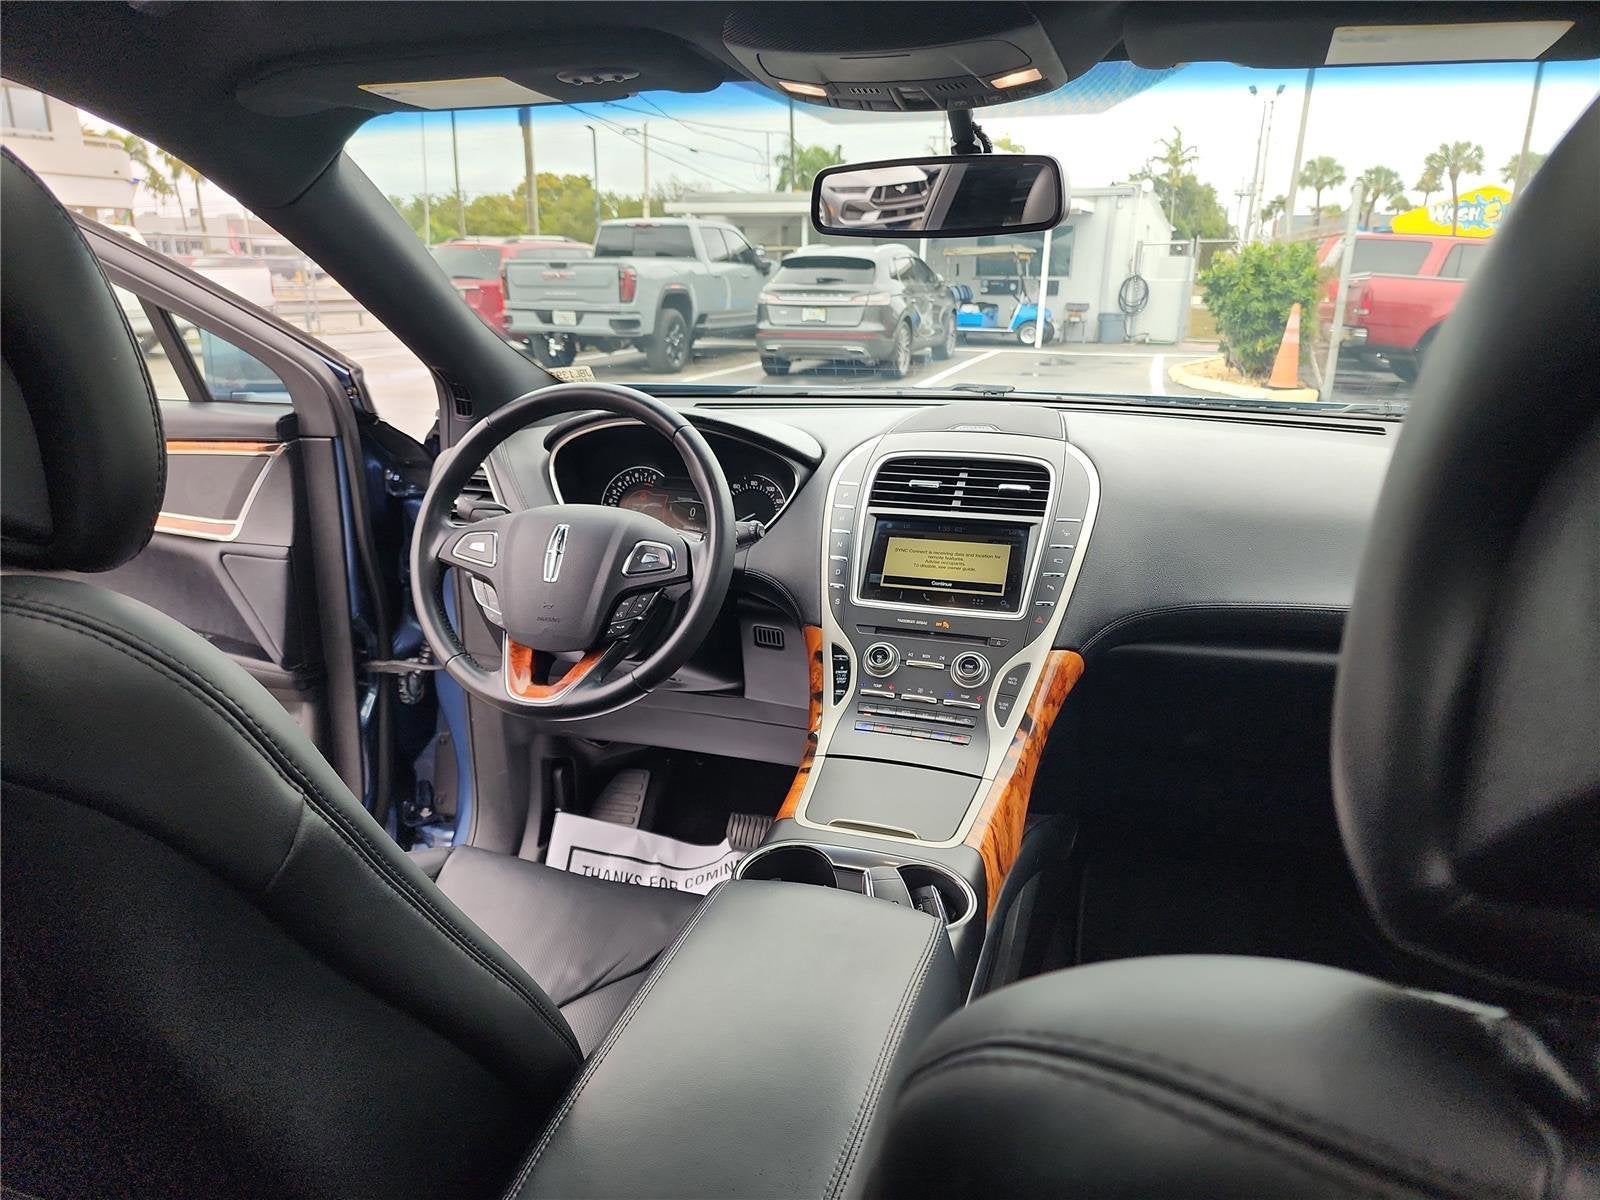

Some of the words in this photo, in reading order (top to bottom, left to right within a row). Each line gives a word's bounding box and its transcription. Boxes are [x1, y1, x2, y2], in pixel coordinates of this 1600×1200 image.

[689, 506, 696, 518] 0
[582, 865, 642, 886] THANKS
[650, 875, 678, 890] FOR
